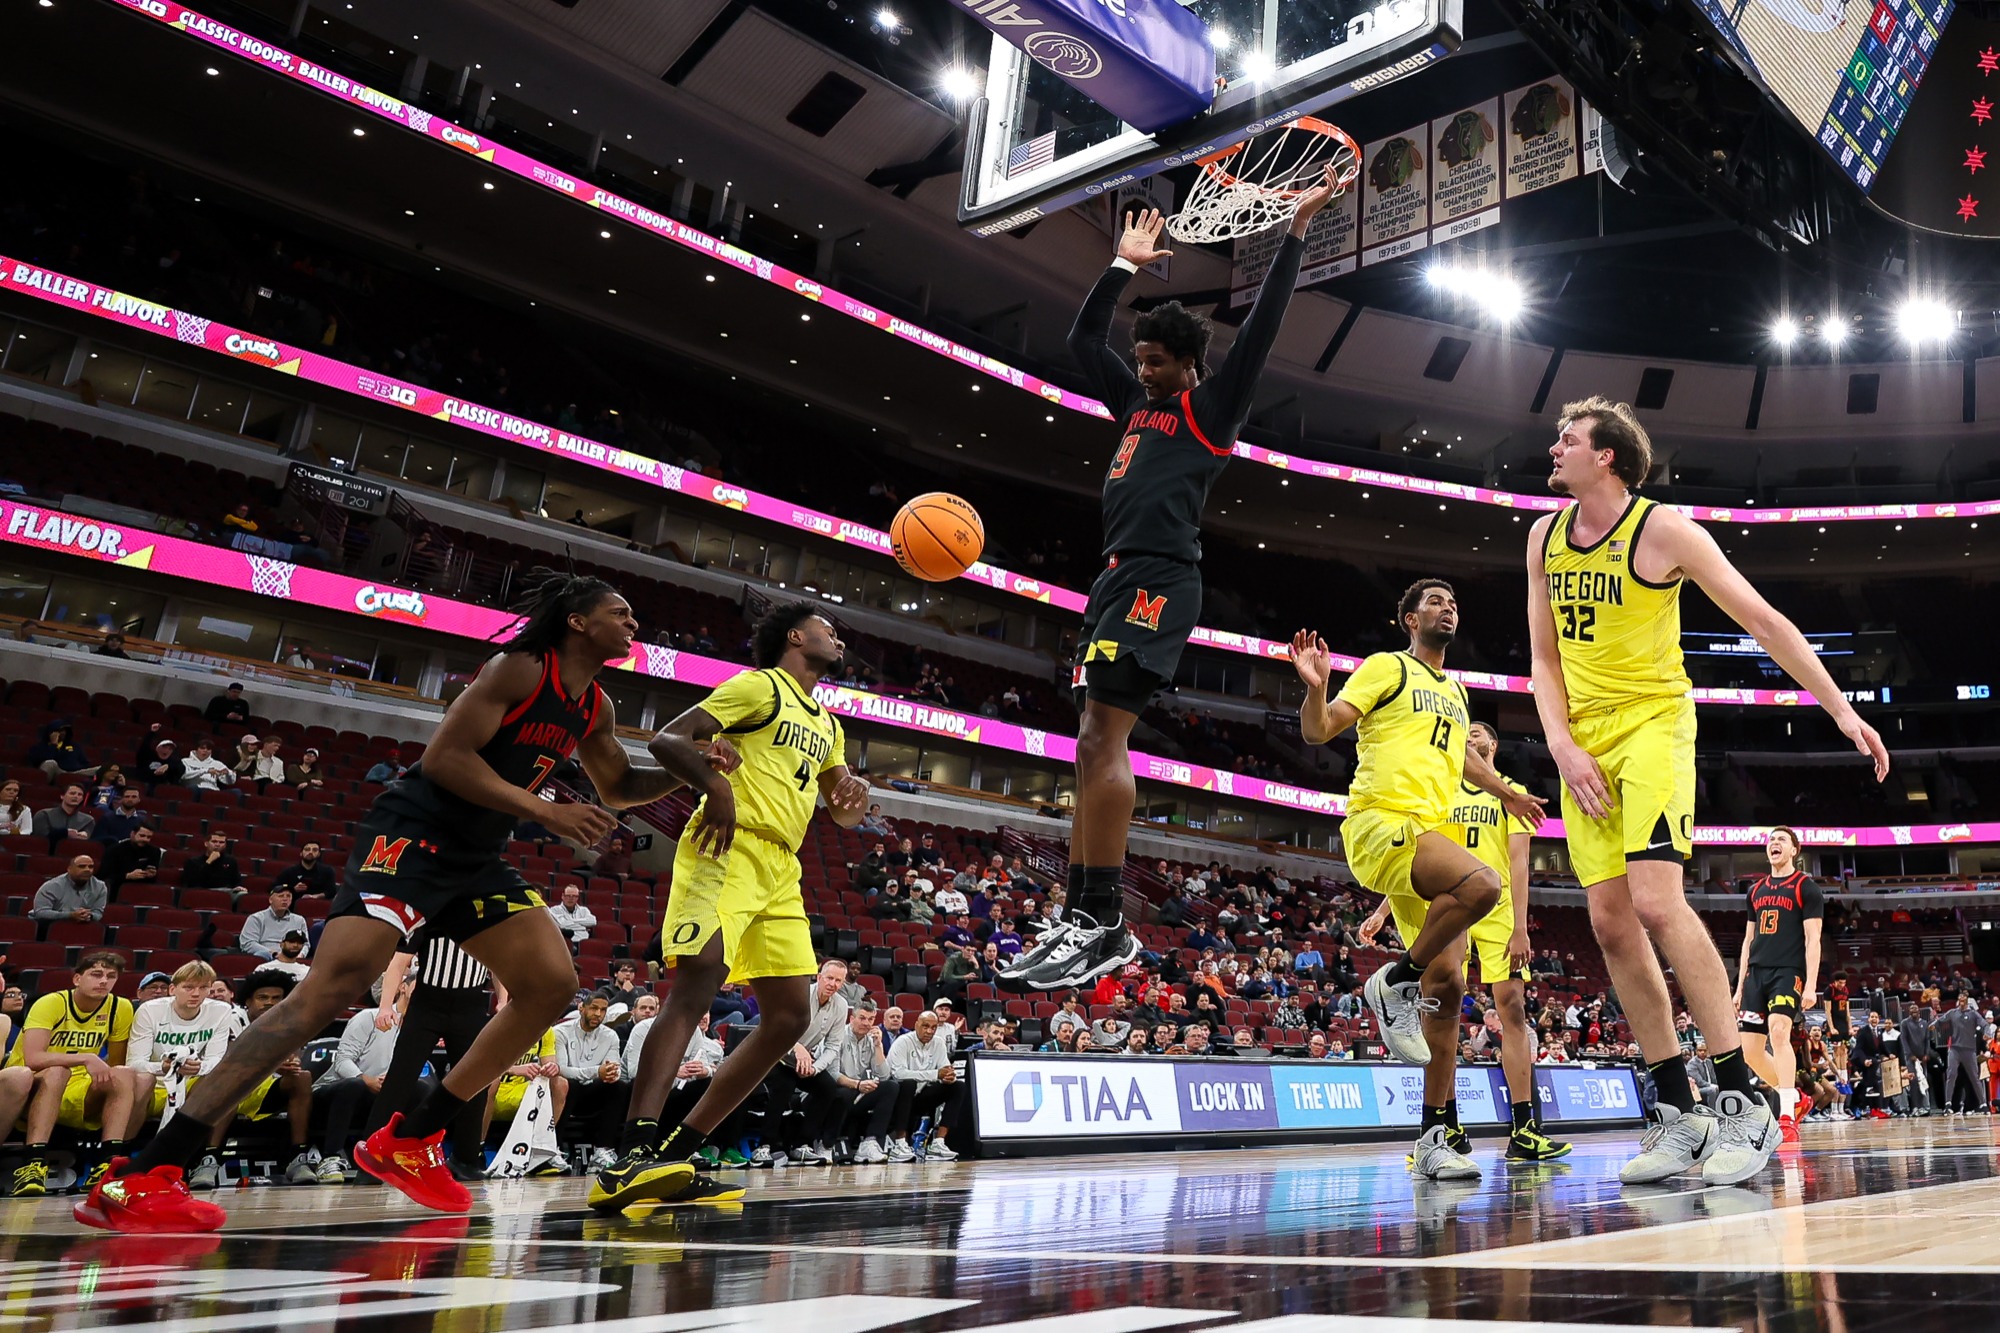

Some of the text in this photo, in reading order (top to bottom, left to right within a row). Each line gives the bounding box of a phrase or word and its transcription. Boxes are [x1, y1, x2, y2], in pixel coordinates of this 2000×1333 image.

[178, 11, 405, 119] CLASSIC HOOPS, BALLER FLAVOR.
[1349, 48, 1438, 92] #B1GMBBT
[1264, 110, 1300, 128] Allstate
[441, 126, 481, 150] Crush
[1523, 131, 1559, 151] CHICAGO
[1181, 144, 1216, 162] Allstate
[1508, 159, 1539, 176] NORRIS
[1540, 145, 1575, 166] DIVISION
[1513, 138, 1569, 164] BLACKHAWKS
[1438, 165, 1491, 190] BLACKHAWKS
[1448, 158, 1482, 177] CHICAGO
[1518, 160, 1566, 183] CHAMPIONS
[1102, 173, 1136, 190] Allstate
[1379, 183, 1412, 202] CHICAGO
[1434, 172, 1497, 202] NORRIS DIVISION
[1524, 173, 1560, 191] 1992-93
[1369, 190, 1420, 214] BLACKHAWKS
[1443, 186, 1488, 208] CHAMPIONS
[594, 189, 637, 218] CLASSIC
[636, 209, 676, 237] HOOPS,
[677, 226, 714, 251] BALLER
[976, 206, 1046, 238] #B1GMBBT
[1363, 196, 1427, 226] SMYTHE DIVISION
[1372, 211, 1416, 232] CHAMPIONS
[1307, 213, 1352, 237] LACKHAWKS
[1324, 221, 1355, 242] DIVISION
[12, 263, 90, 304] BALLER
[91, 288, 172, 329] FLAVOR.
[889, 317, 922, 341] CLASSIC
[225, 334, 281, 361] Crush
[1126, 408, 1179, 437] RYLAND
[442, 398, 660, 479] CLASSIC HOOPS, BALLER FLAVOR.
[1108, 434, 1141, 479] 9
[349, 495, 370, 509] 201
[712, 485, 749, 505] Crush
[8, 508, 128, 558] FLAVOR.
[839, 522, 879, 547] CLASSIC
[354, 586, 426, 617] Crush
[1126, 588, 1169, 627] M
[1558, 604, 1596, 642] 32
[1709, 643, 1731, 652] MEN'S
[1412, 688, 1466, 728] OREGON
[1856, 690, 1875, 701] PM
[861, 698, 913, 723] BALLER
[915, 708, 970, 736] FLAVOR.
[1430, 715, 1451, 752] 13
[525, 754, 556, 793] 7
[793, 758, 811, 792] 4
[1264, 783, 1299, 804] CLASSIC
[1299, 791, 1336, 814] HOOPS,
[1466, 826, 1480, 849] 0
[1691, 829, 1725, 841] LASSIC
[1725, 828, 1766, 845] HOOPS,
[1805, 828, 1848, 843] FLAVOR.
[361, 835, 412, 870] M
[1752, 895, 1794, 912] MARYLAND
[1759, 910, 1780, 935] 13
[50, 1031, 106, 1048] OREGON
[155, 1028, 214, 1046] LOCK IT IN
[1401, 1077, 1423, 1087] GET A
[1051, 1075, 1153, 1122] TIAA
[1188, 1082, 1266, 1112] LOCK IN
[1289, 1082, 1363, 1110] THE WIN
[1456, 1090, 1485, 1101] REMENT
[1406, 1104, 1422, 1115] CHE
